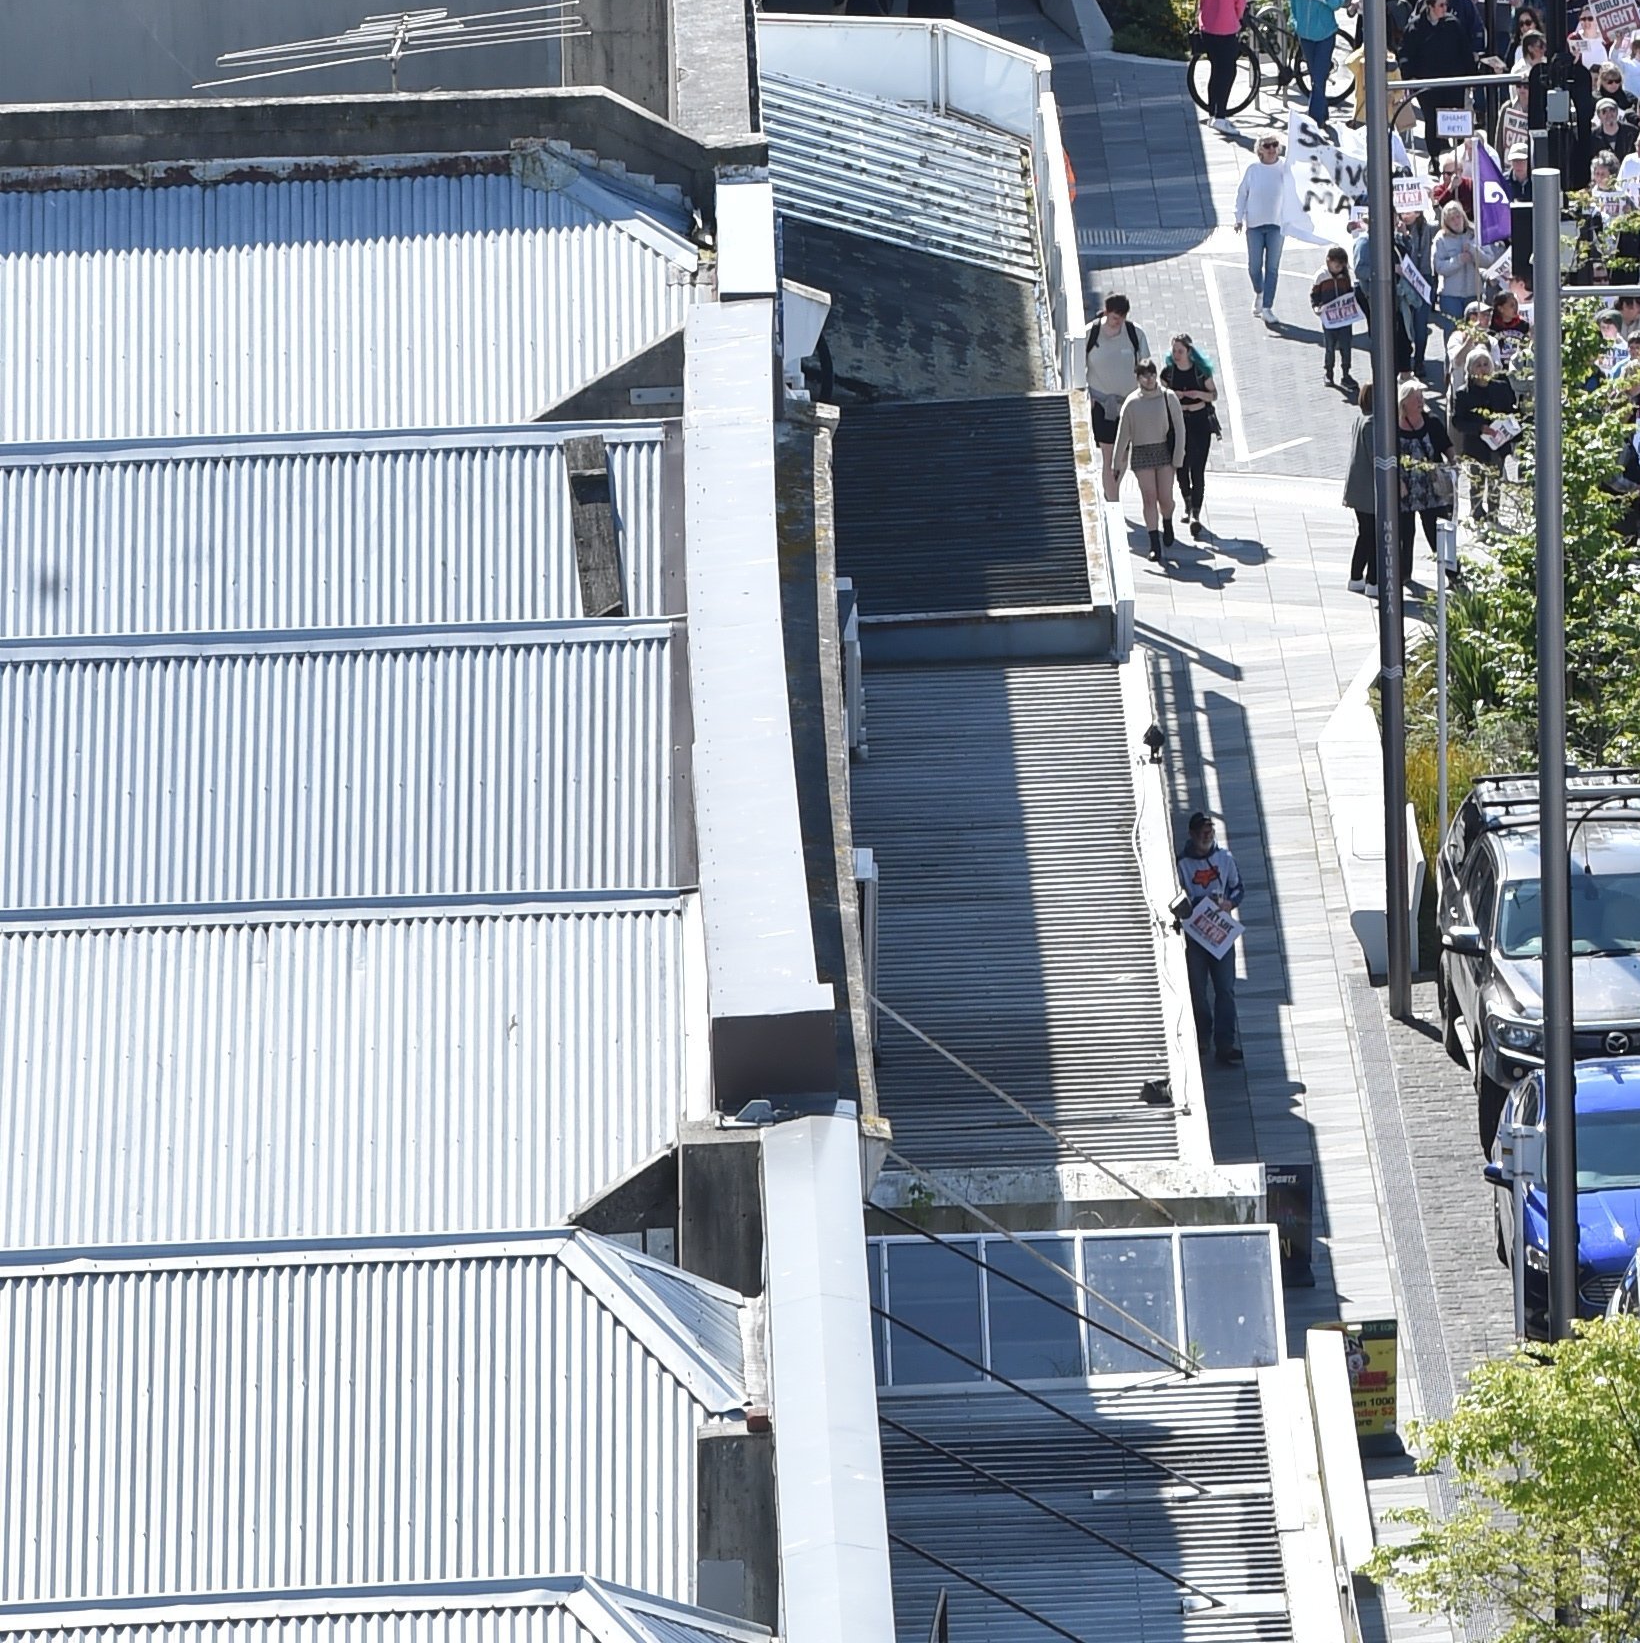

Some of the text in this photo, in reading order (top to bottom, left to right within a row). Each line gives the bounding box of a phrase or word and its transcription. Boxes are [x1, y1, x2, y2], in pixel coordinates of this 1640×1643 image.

[1600, 8, 1639, 32] RIGHT
[1441, 115, 1469, 123] SHAME
[1447, 125, 1463, 133] RETI
[1383, 521, 1394, 614] MOTURATA
[1266, 1174, 1298, 1185] SPORTS
[1370, 1397, 1395, 1407] 1000
